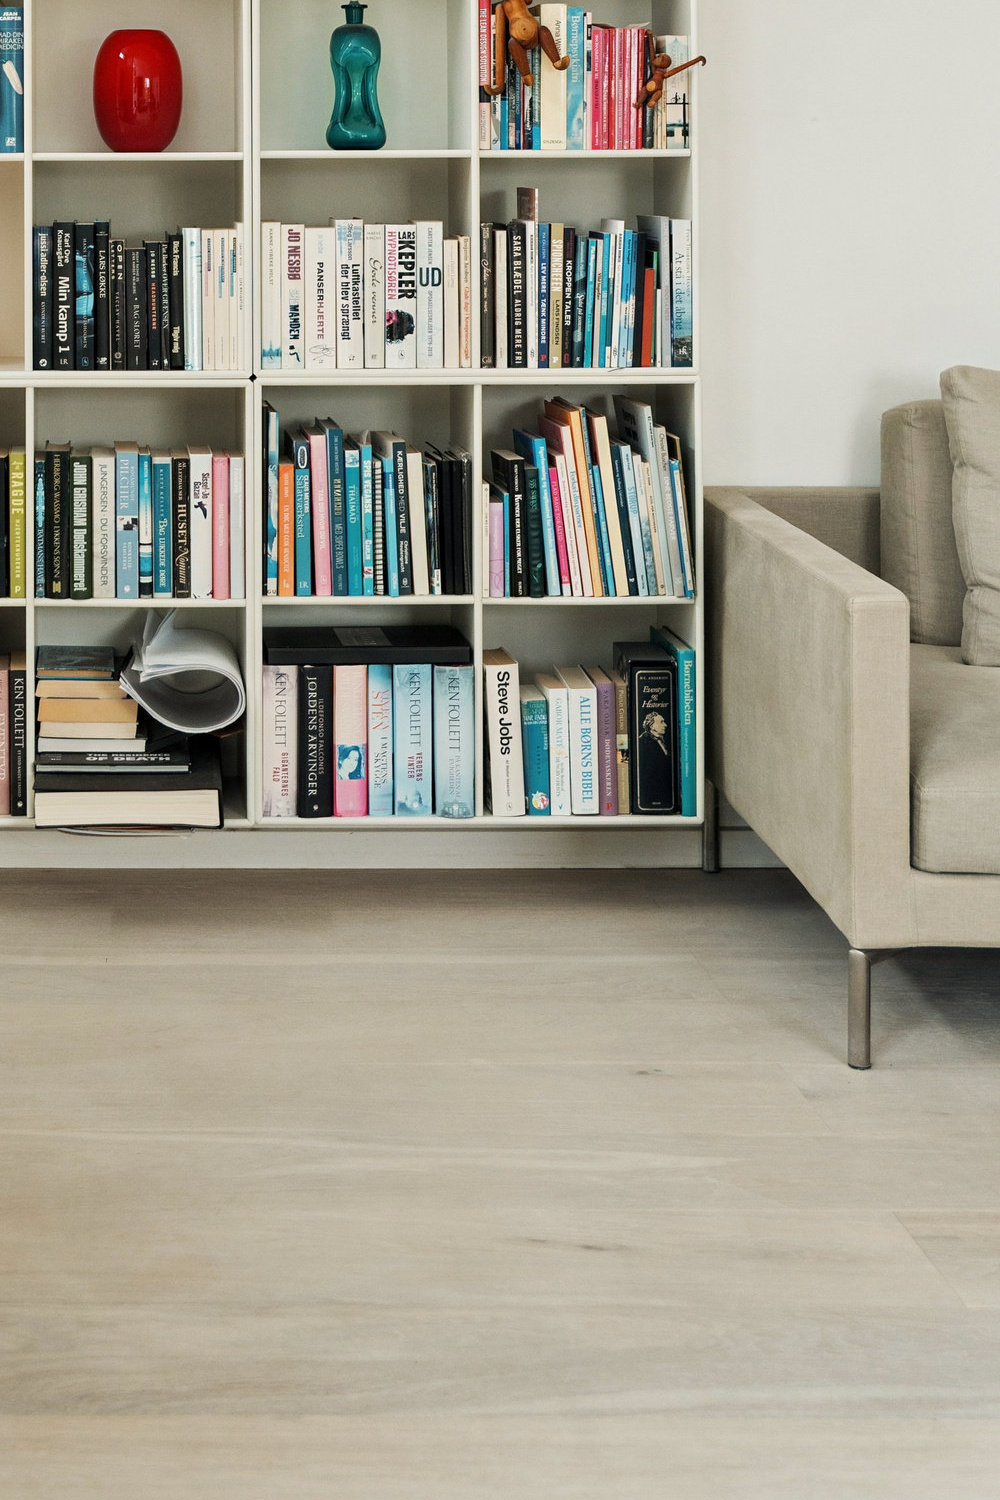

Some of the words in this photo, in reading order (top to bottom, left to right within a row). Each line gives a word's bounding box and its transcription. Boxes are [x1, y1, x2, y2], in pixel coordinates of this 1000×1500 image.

[568, 16, 580, 83] Børnepsykiatri
[56, 230, 64, 266] Knausgård
[287, 229, 301, 242] JO
[398, 231, 415, 240] LARS
[513, 235, 521, 256] SARA
[287, 245, 301, 280] NESBØ
[341, 264, 350, 279] der
[388, 231, 396, 300] HYPNOTISØREN
[398, 240, 416, 299] KEPLER
[551, 239, 563, 292] SPIONCHEFEN
[674, 252, 685, 264] At
[674, 267, 685, 279] stå
[59, 276, 69, 300] Min
[341, 282, 350, 300] blev
[352, 264, 360, 320] Luftkastellet
[419, 267, 441, 287] UD
[513, 260, 521, 295] BLÆDEL
[564, 260, 572, 299] KROPPEN
[513, 299, 521, 325] ALDRIG
[564, 300, 572, 326] TALER
[674, 289, 685, 304] det
[56, 305, 70, 341] kamp
[341, 304, 350, 340] sprængt
[674, 306, 685, 330] åbne
[513, 329, 521, 348] MERE
[513, 352, 521, 364] FRI
[73, 462, 87, 485] JOHN
[120, 459, 129, 509] PILCHER
[201, 472, 209, 499] Sissel-Jo
[364, 460, 372, 478] SPIS
[12, 472, 24, 514] RAGDE
[100, 464, 108, 512] JUNGERSEN
[194, 482, 202, 499] Gazan
[348, 484, 356, 523] THAIMAD
[364, 480, 372, 514] VEGANSK
[514, 494, 522, 517] KVINDER
[73, 487, 87, 526] GRISHAM
[296, 474, 304, 538] Salatværksted
[100, 518, 108, 531] DU
[73, 529, 87, 591] Dødskammeret
[100, 534, 108, 586] FORSVINDER
[14, 678, 24, 700] KEN
[274, 673, 287, 696] KEN
[409, 672, 421, 696] KEN
[448, 677, 460, 701] KEN
[497, 671, 510, 714] Steve
[684, 660, 693, 725] Børnebibelen
[306, 676, 317, 730] JORDENS
[580, 696, 590, 724] ALLE
[14, 704, 24, 747] FOLLETT
[274, 700, 287, 747] FOLLETT
[409, 700, 421, 747] FOLLETT
[448, 704, 460, 752] FOLLETT
[499, 718, 512, 755] Jobs
[580, 726, 592, 768] BØRNS
[306, 735, 317, 796] ARVINGER
[582, 771, 592, 802] BIBEL
